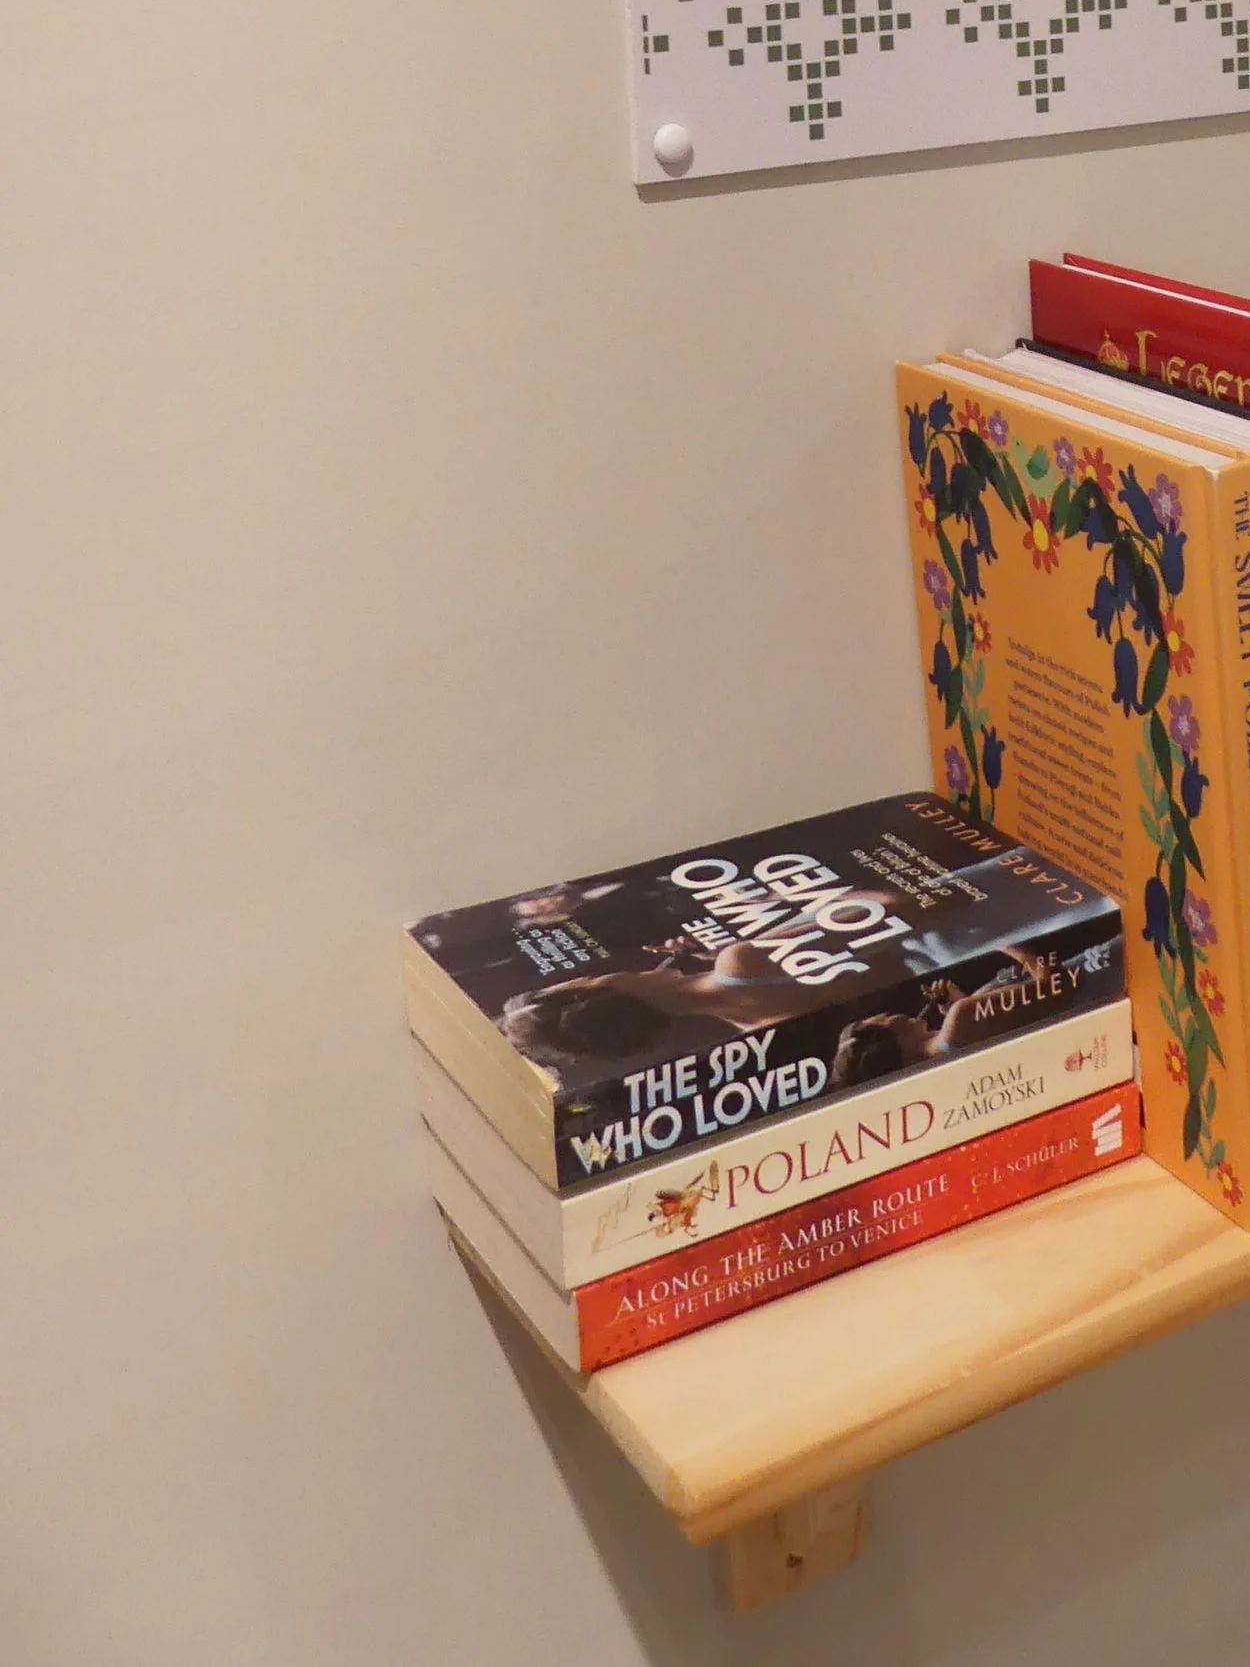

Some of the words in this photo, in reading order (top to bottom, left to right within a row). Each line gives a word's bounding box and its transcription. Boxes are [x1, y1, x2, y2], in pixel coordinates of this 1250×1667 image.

[1233, 491, 1250, 541] THE
[906, 801, 1001, 852] MULLEY
[671, 859, 792, 937] WHO
[753, 854, 912, 949] LOVED
[999, 854, 1083, 904] CLARE
[681, 917, 736, 950] THE
[749, 931, 870, 984] SPY
[975, 966, 1080, 1022] MULLEY
[997, 952, 1057, 982] CLARE
[624, 1055, 697, 1115] THE
[708, 1029, 775, 1088] SPY
[966, 1063, 1023, 1099] ADAM
[571, 1105, 682, 1174] WHO
[694, 1057, 827, 1135] LOVED
[943, 1076, 1045, 1130] ZAMOYSKI
[726, 1100, 934, 1209] POLAND
[612, 1265, 708, 1318] ALONG
[720, 1241, 769, 1275] THE
[778, 1208, 861, 1255] AMBER
[872, 1174, 950, 1218] ROUTE
[674, 1253, 811, 1320] PETERSBURG
[816, 1241, 844, 1262] TO
[850, 1209, 923, 1248] VENICE
